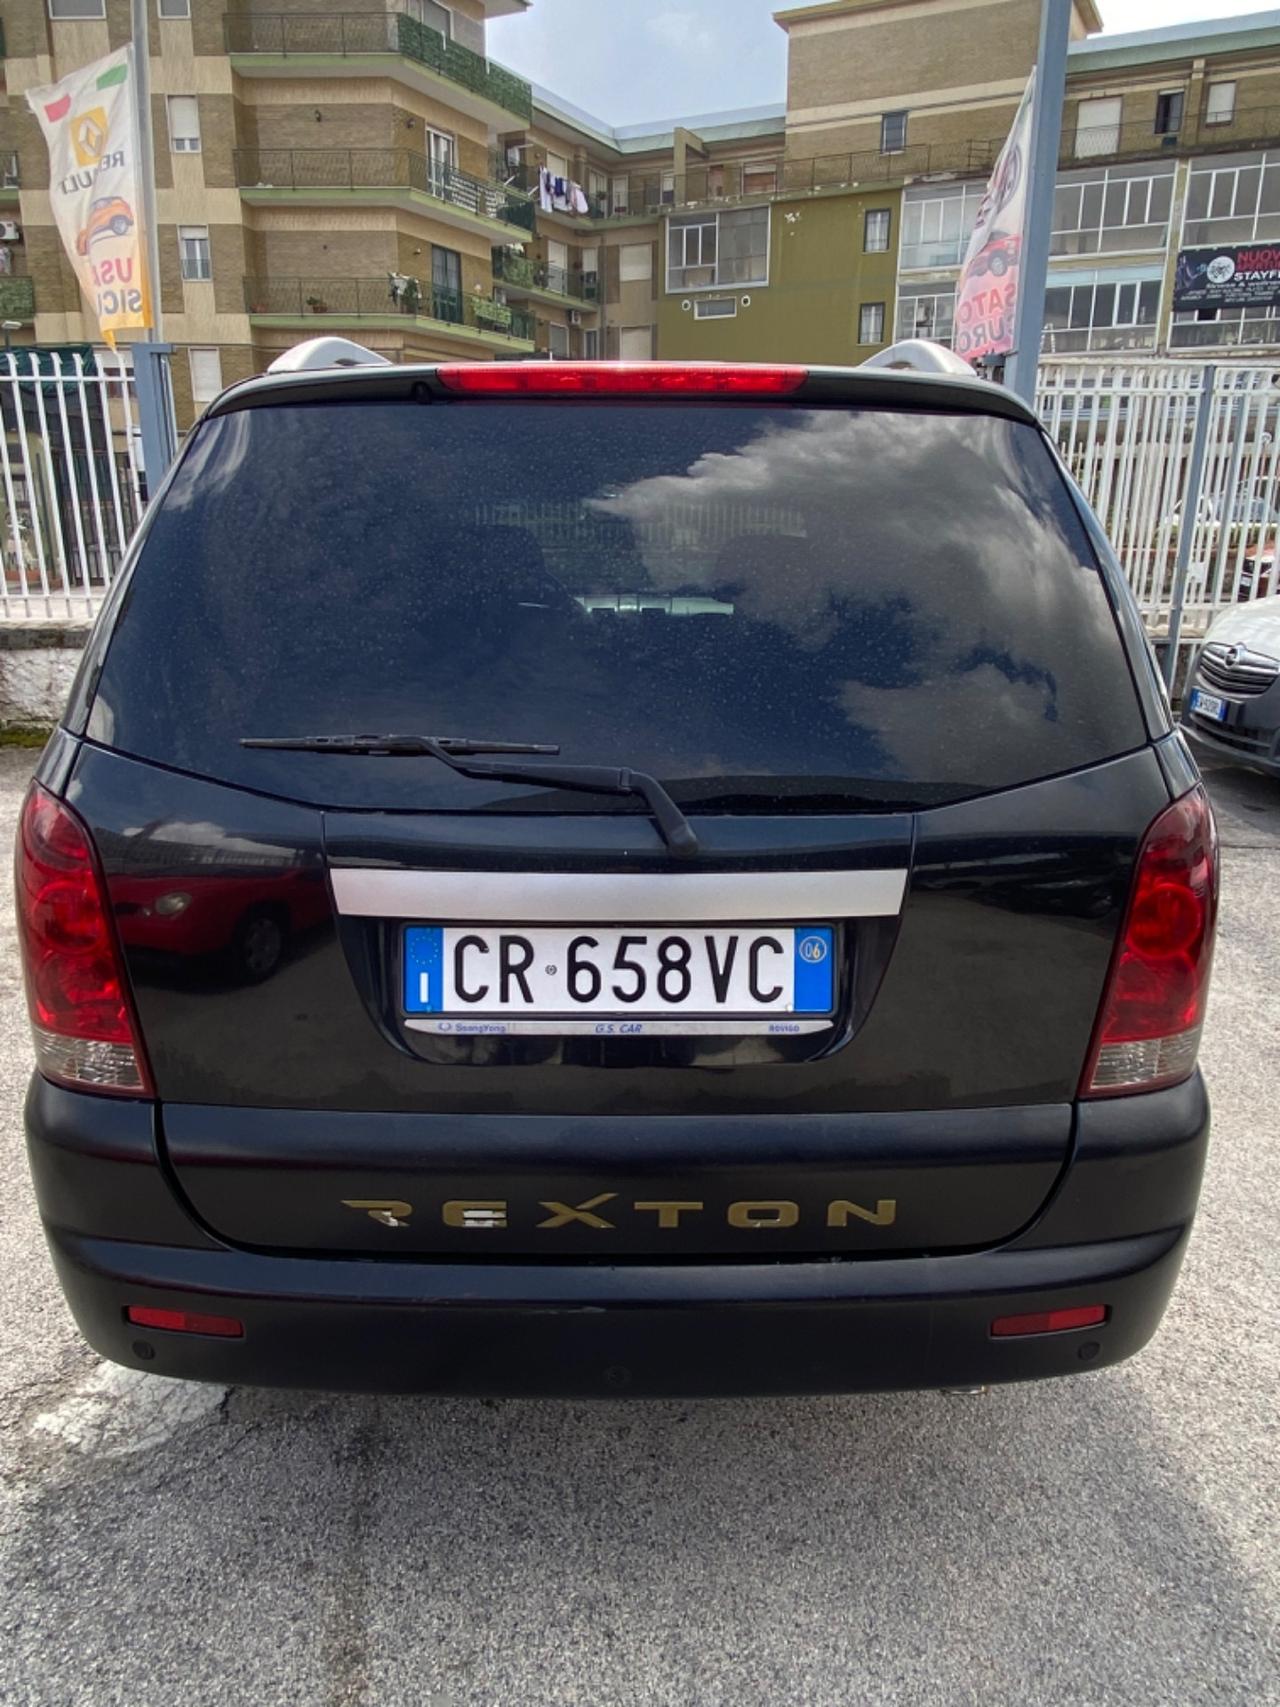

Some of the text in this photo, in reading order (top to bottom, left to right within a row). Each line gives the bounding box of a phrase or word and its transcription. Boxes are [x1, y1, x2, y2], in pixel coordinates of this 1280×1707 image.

[420, 935, 820, 1003] I CR 658VC 06
[618, 1023, 643, 1034] CAR
[341, 1193, 897, 1229] REXTON
